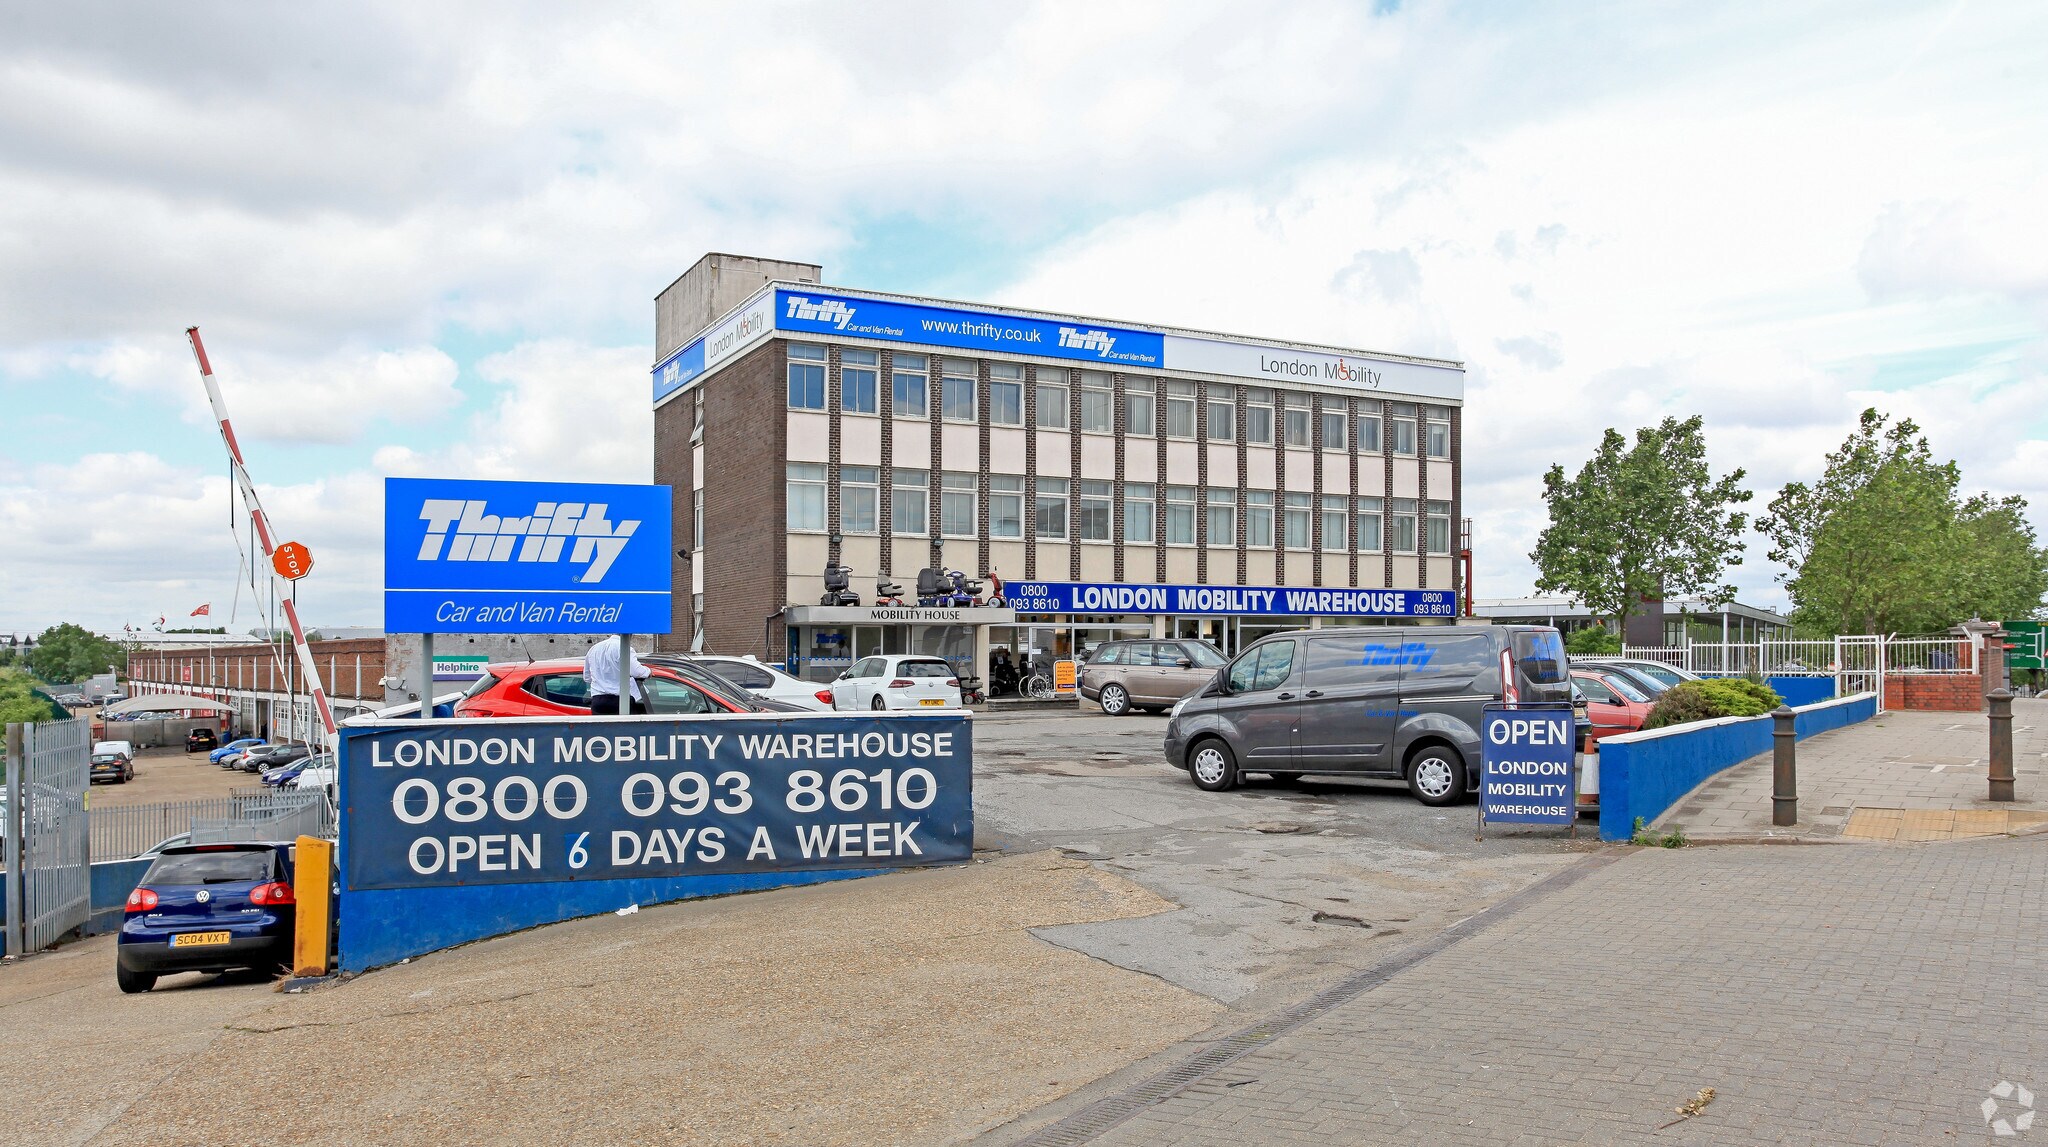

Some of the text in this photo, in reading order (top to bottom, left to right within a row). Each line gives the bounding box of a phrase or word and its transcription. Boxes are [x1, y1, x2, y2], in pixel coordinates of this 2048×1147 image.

[786, 296, 857, 330] Thrifty
[847, 322, 904, 337] Car and Van Rental
[921, 318, 1042, 343] www.thrifty.co.uk
[709, 331, 735, 359] London
[1058, 326, 1117, 358] Thrifty
[1260, 354, 1318, 378] London
[416, 498, 642, 584] Thrifty
[283, 545, 300, 575] STOP
[1020, 584, 1048, 597] 0800
[1072, 586, 1405, 613] LONDON MOBILITY WAREHOUSE
[1422, 592, 1443, 603] 0800
[435, 600, 623, 623] Car and Van Rental
[870, 609, 960, 620] MOBILITY HOUSE
[1009, 598, 1060, 610] 093 8610
[1413, 603, 1451, 615] 093 8610
[437, 662, 480, 673] Helphire
[1362, 642, 1438, 673] Thrifty
[1489, 719, 1567, 745] OPEN
[371, 731, 954, 768] LONDON MOBILITY WAREHOUSE
[1488, 760, 1567, 776] LONDON
[391, 766, 938, 825] 0800 093 8610
[1488, 783, 1567, 797] MOBILITY
[1488, 804, 1567, 816] WAREHOUSE
[408, 821, 924, 876] OPEN 6 DAYS A WEEK
[177, 932, 227, 945] SC04 VXT
